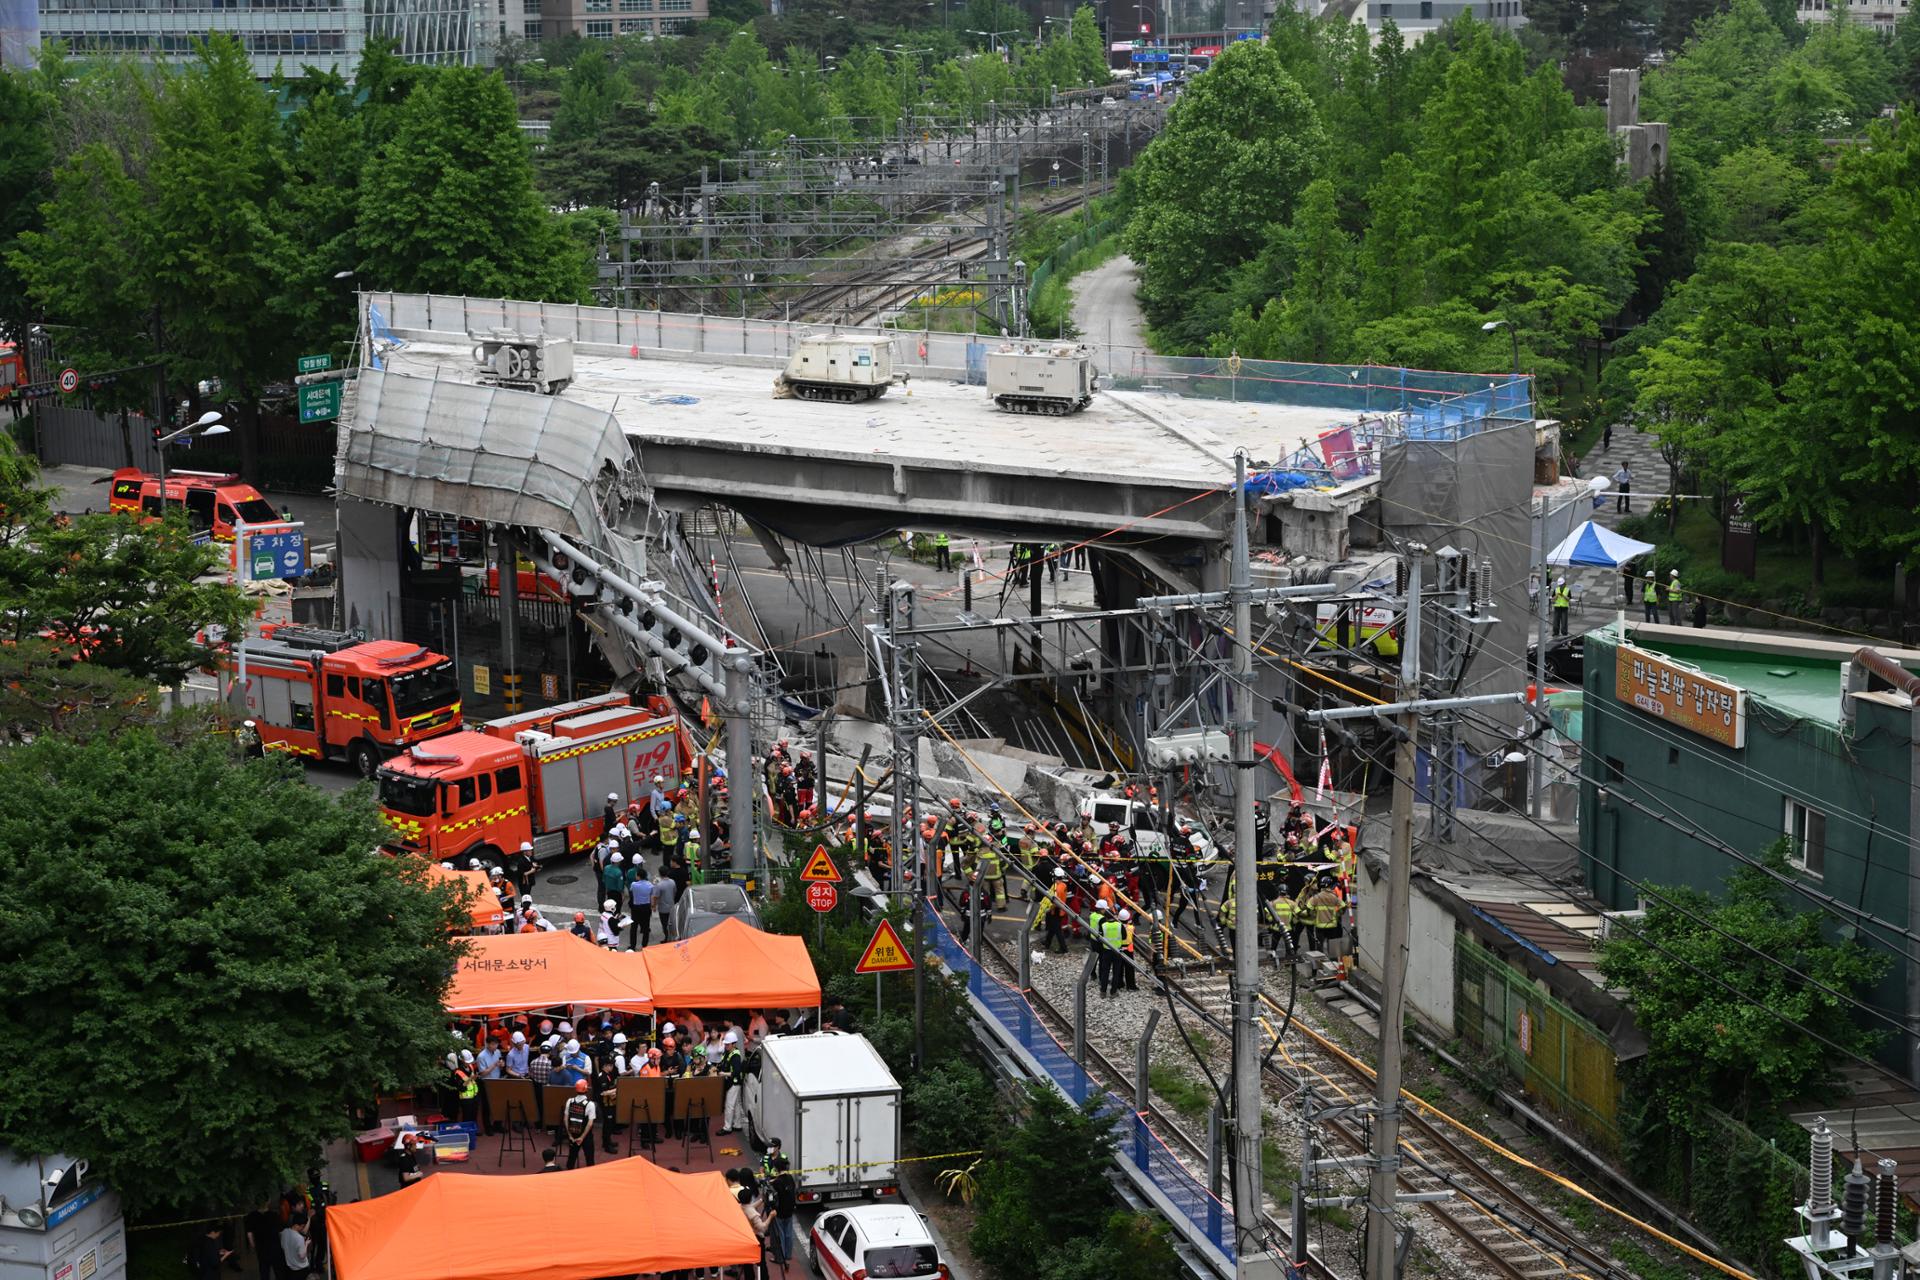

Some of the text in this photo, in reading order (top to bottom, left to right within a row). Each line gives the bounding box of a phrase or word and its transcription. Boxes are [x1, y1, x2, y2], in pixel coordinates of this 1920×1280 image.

[64, 375, 75, 386] 40
[253, 534, 301, 550] 주차장
[634, 741, 671, 769] 119
[633, 764, 675, 787] 구조대
[811, 886, 832, 897] 정지
[811, 899, 833, 907] STOP
[875, 946, 895, 957] 위험
[463, 958, 547, 972] 서대문소방서
[871, 956, 898, 964] DANGER
[75, 1159, 89, 1189] P
